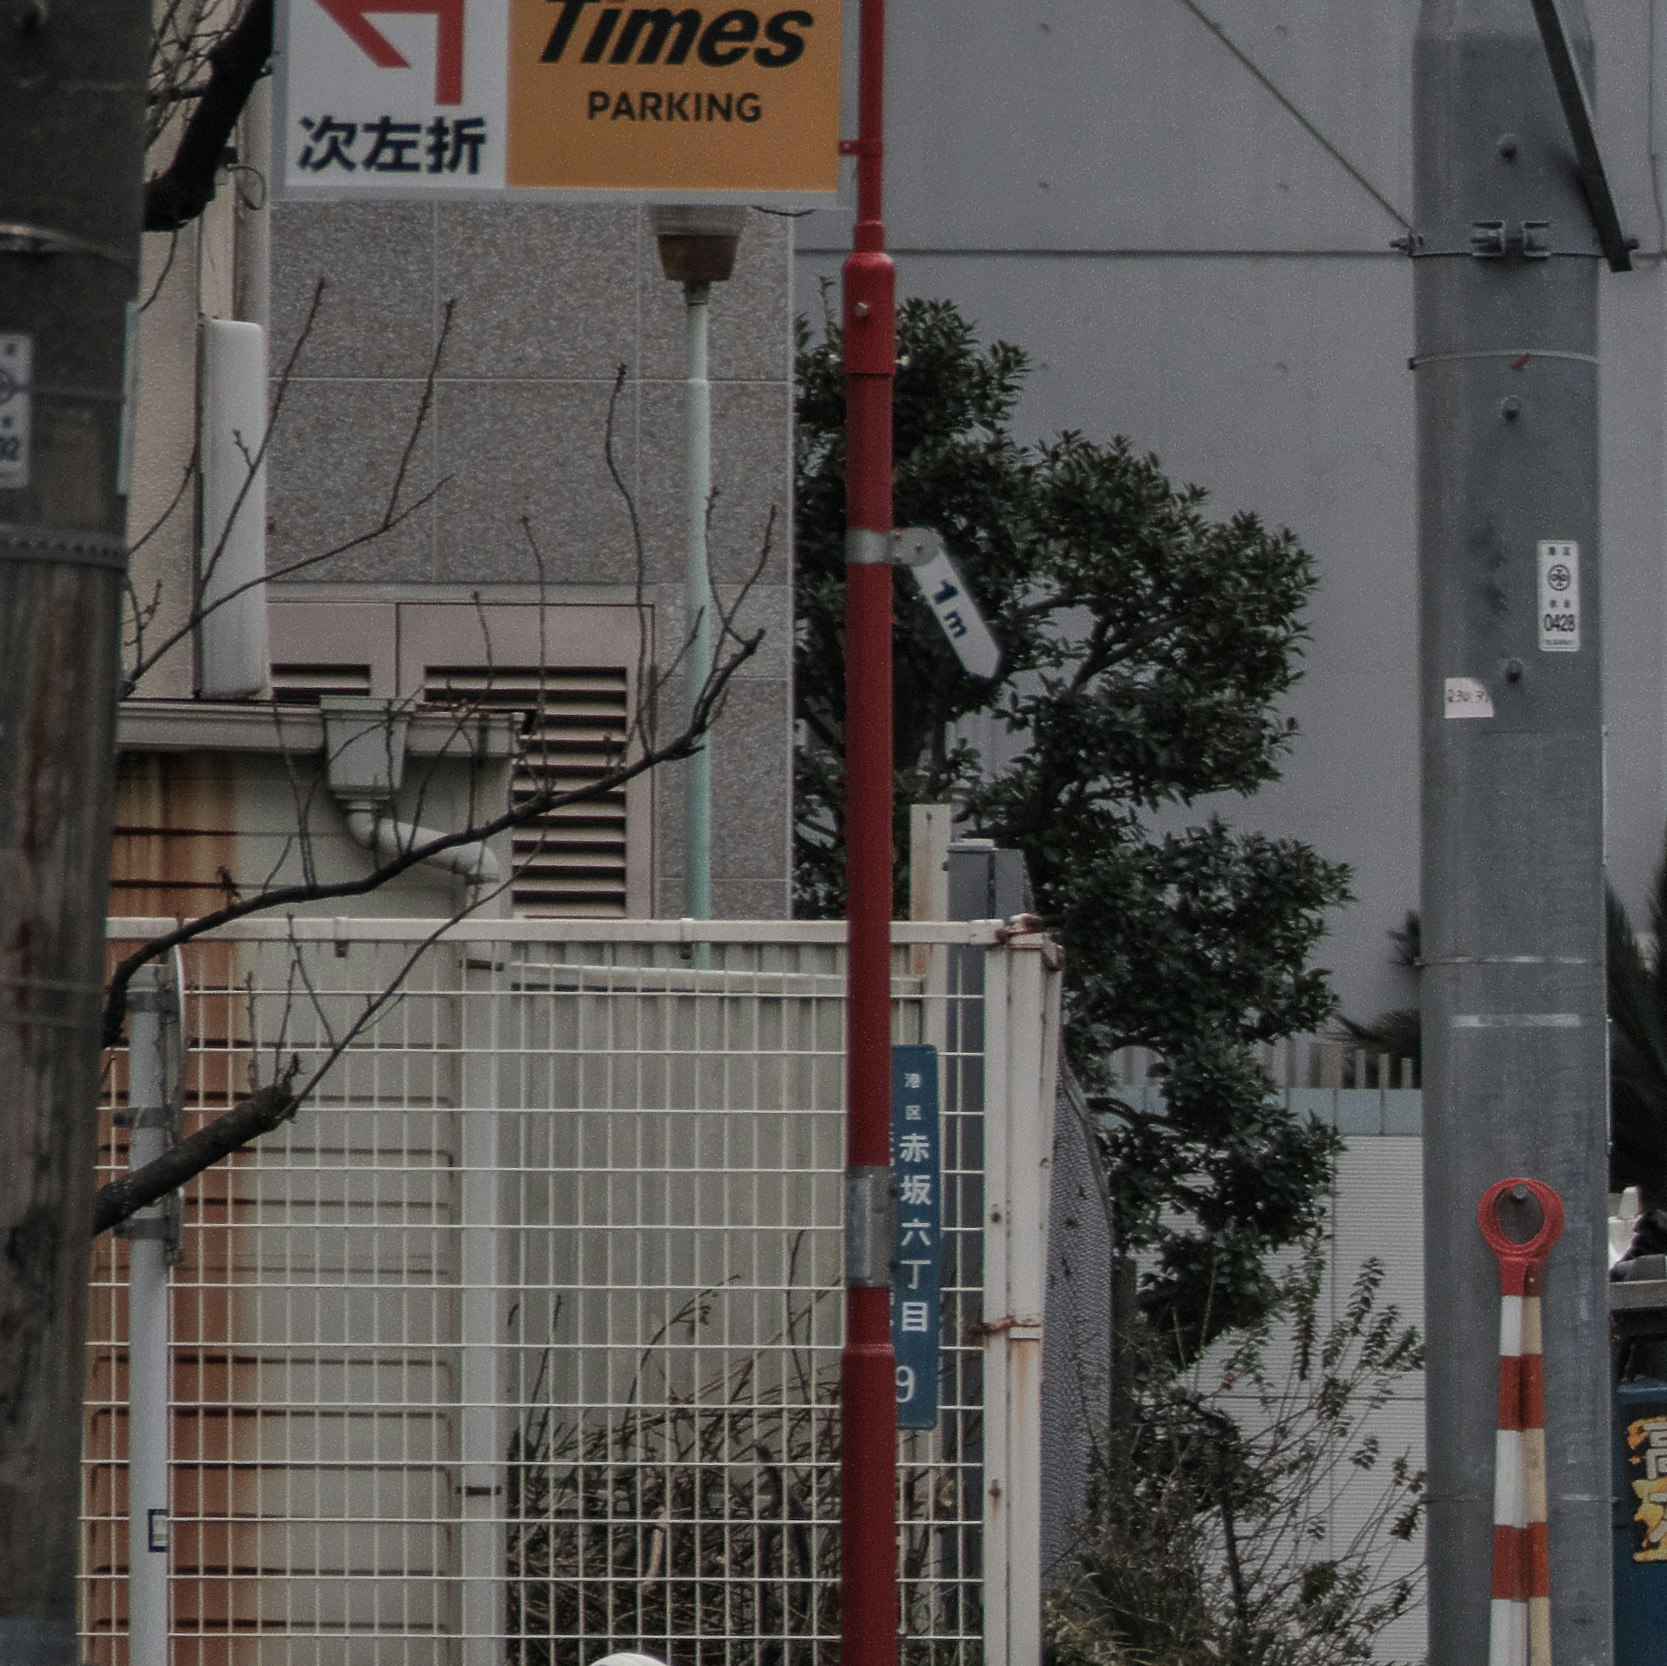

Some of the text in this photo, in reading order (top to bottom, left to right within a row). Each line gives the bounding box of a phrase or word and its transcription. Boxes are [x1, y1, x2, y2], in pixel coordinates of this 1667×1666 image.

[540, 0, 814, 68] Times
[588, 91, 762, 123] PARKING
[298, 114, 487, 175] 次左折
[899, 1133, 932, 1333] 赤坂六丁目
